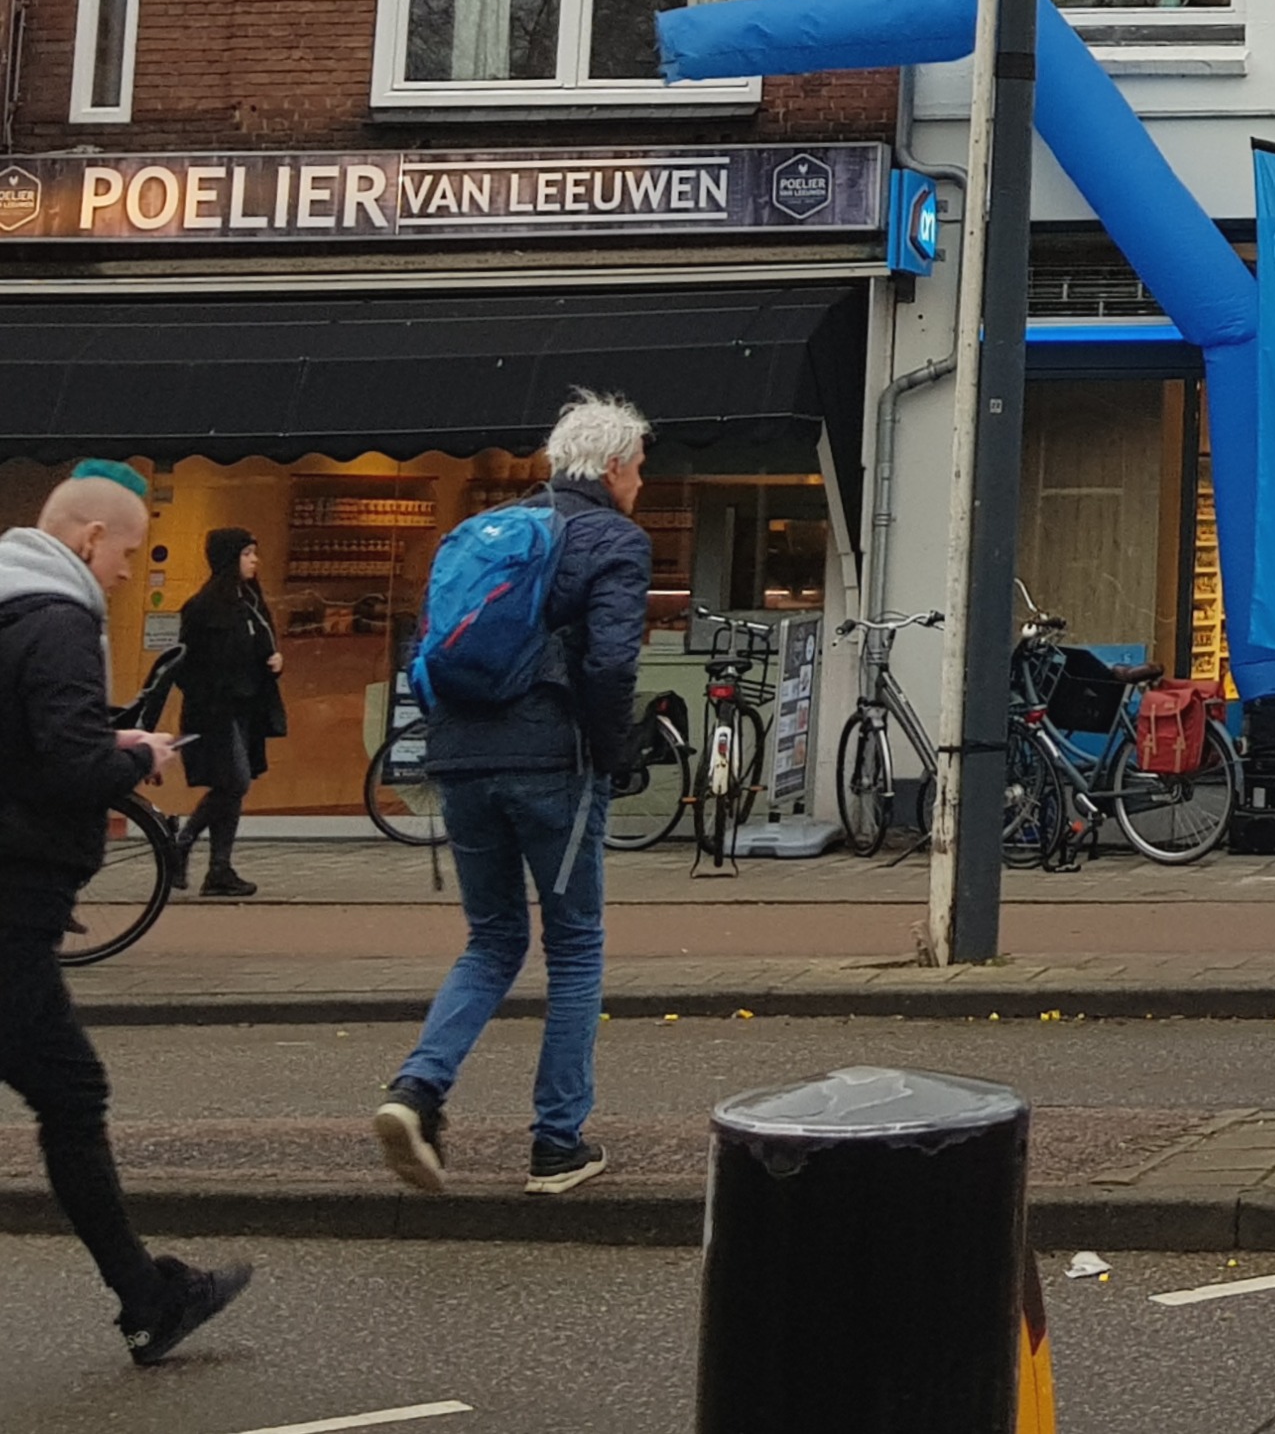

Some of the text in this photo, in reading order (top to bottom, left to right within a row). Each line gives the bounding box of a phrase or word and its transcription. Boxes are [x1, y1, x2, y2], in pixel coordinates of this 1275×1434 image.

[80, 164, 728, 230] POELIER VAN LEEUWEN
[780, 177, 827, 189] POELIER
